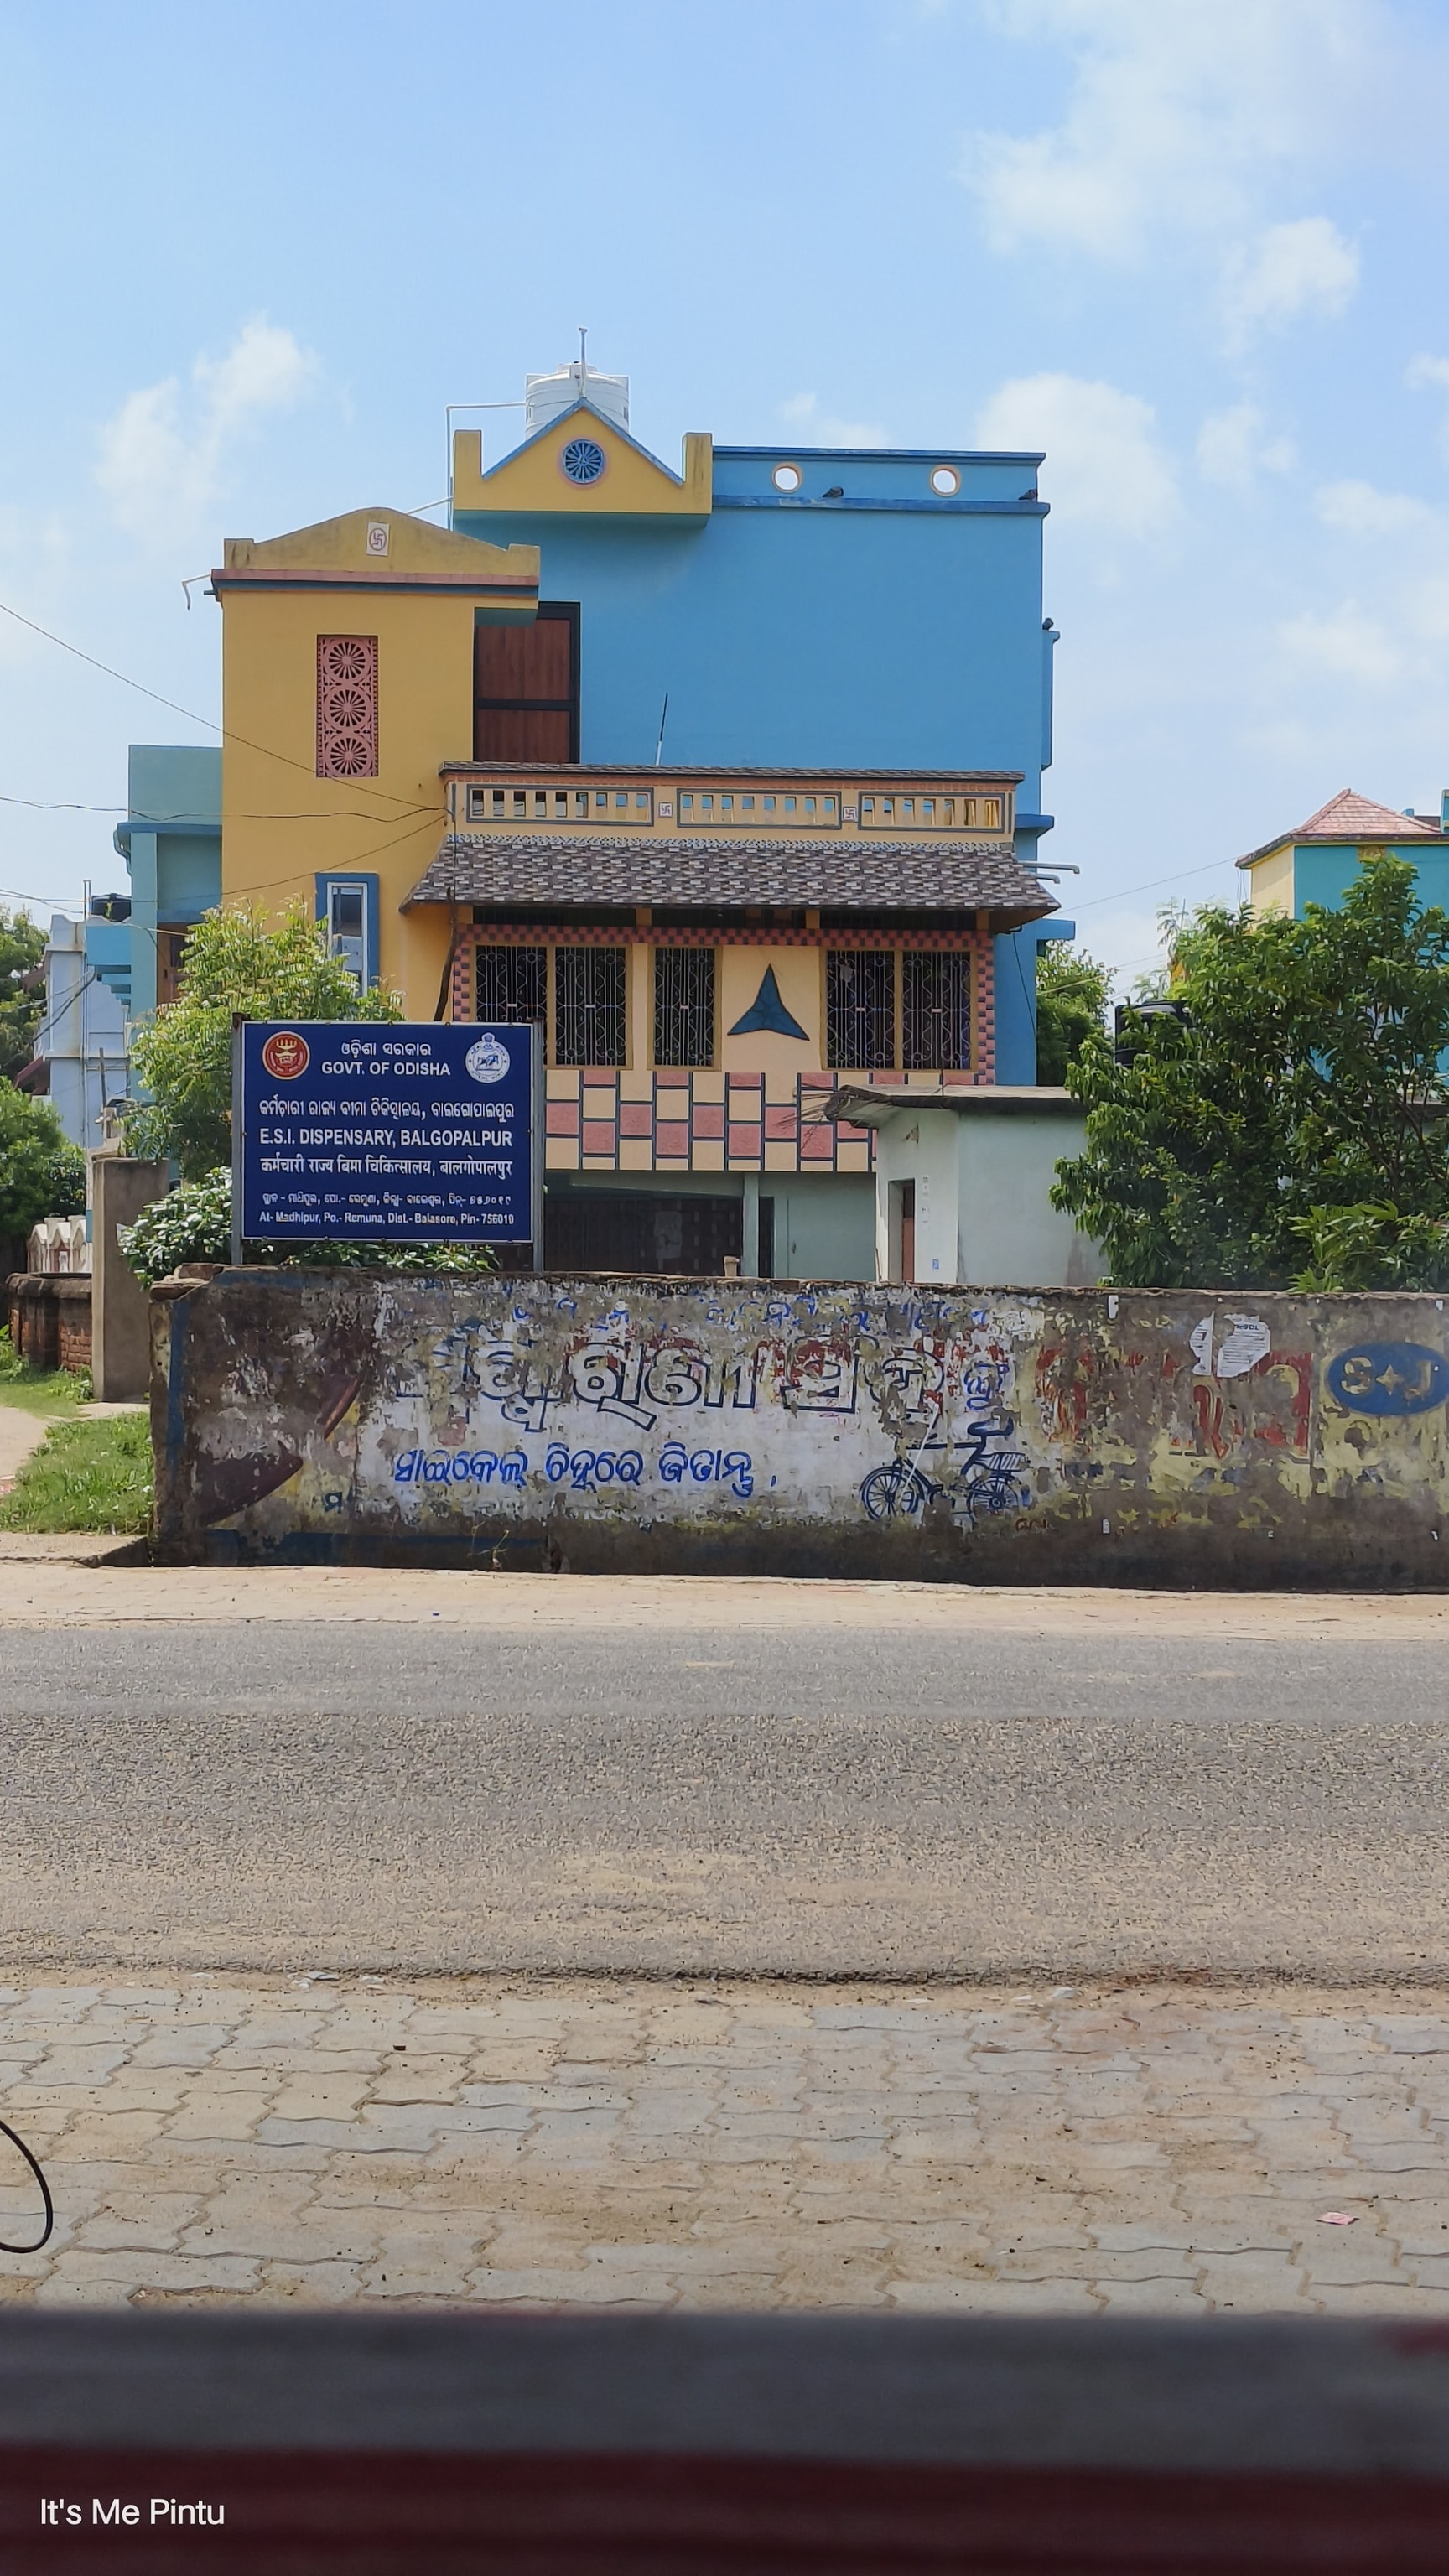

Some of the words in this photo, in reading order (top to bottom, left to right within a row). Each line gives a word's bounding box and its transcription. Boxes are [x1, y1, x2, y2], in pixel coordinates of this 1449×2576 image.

[341, 1039, 377, 1059] ଓଡ଼ିଶା
[382, 1042, 431, 1057] ସରକାର
[321, 1061, 365, 1075] GOVT.
[369, 1062, 390, 1075] OF
[393, 1062, 451, 1077] ODISHA
[259, 1093, 304, 1118] କର୍ମଚାରୀ
[308, 1100, 336, 1116] ରାଜ୍ୟ
[340, 1101, 366, 1116] ବୀମା
[260, 1128, 295, 1145] E.S.I.
[299, 1128, 396, 1149] DISPENSARY,
[400, 1130, 513, 1147] BALGOPALPUR
[259, 1151, 304, 1173] कर्मचारी
[307, 1158, 335, 1173] राज्य
[336, 1153, 362, 1173] बिमा
[365, 1154, 435, 1177] चिकित्सालय,
[439, 1151, 513, 1180] बालगोपालपुर
[259, 1211, 274, 1222] At-
[324, 1212, 342, 1223] Po.-
[344, 1212, 386, 1224] Remuna,
[387, 1212, 413, 1223] Dist.-
[414, 1213, 459, 1226] Balasore,
[460, 1213, 480, 1224] Pin-
